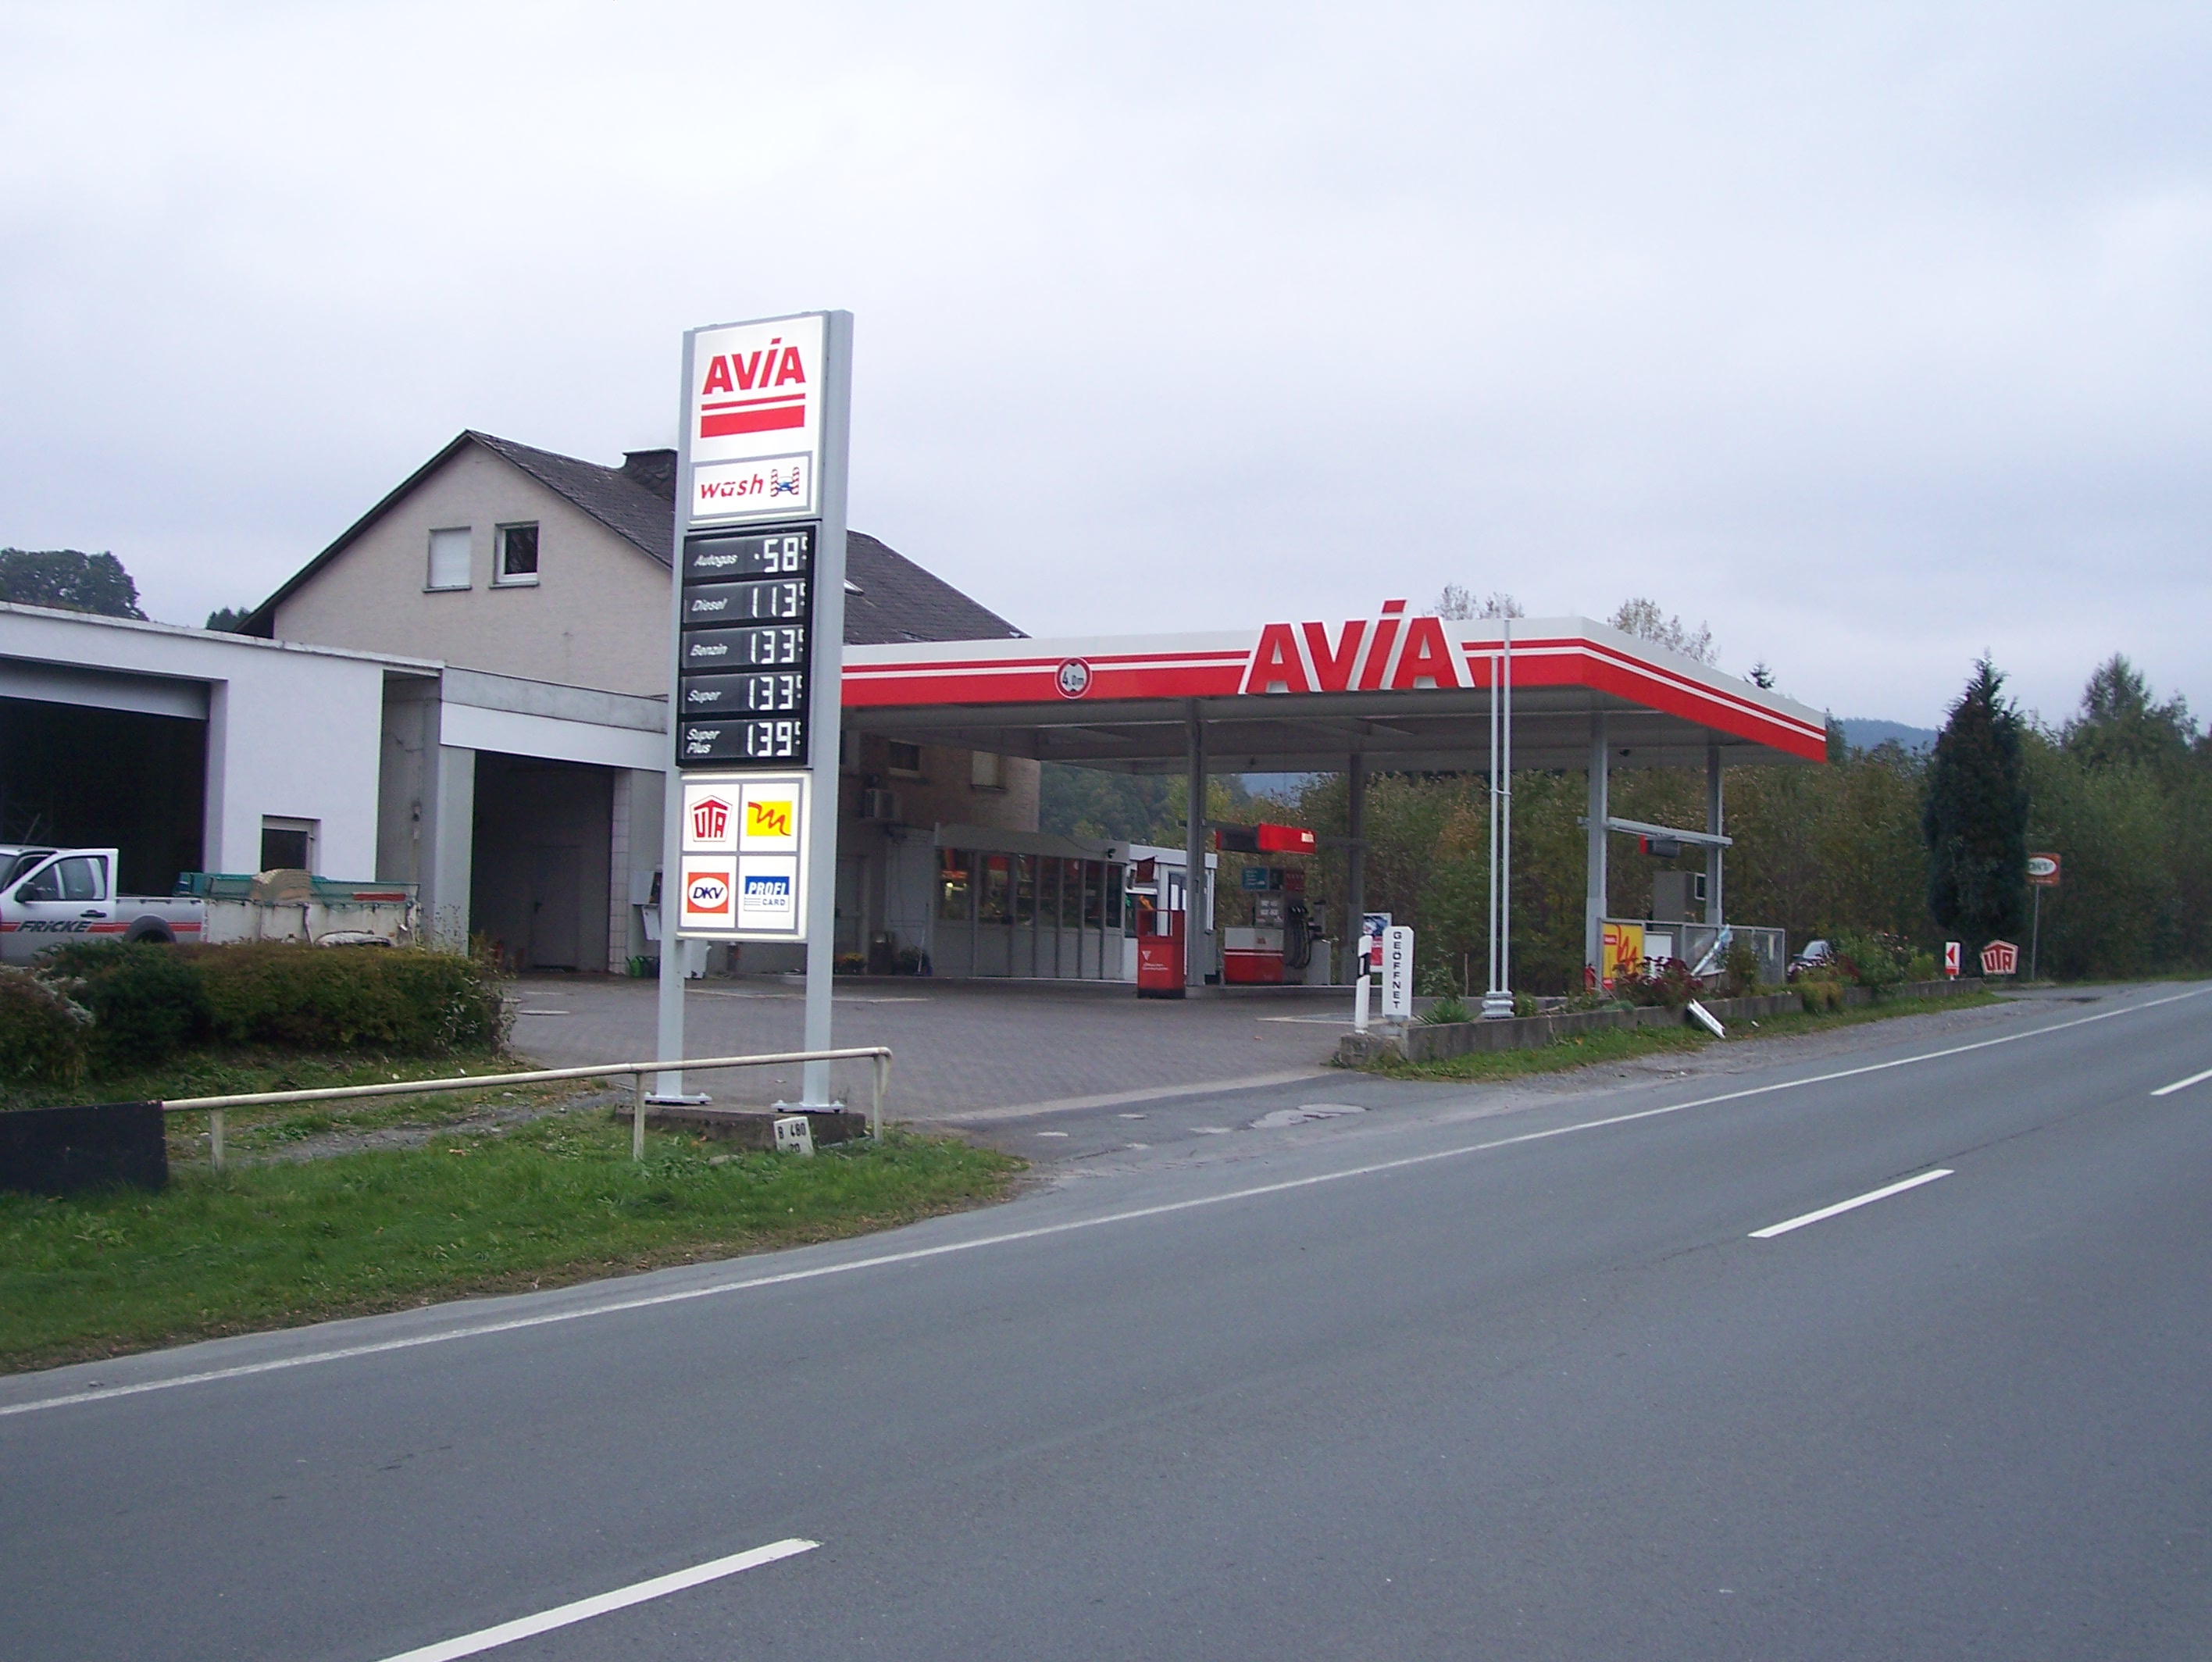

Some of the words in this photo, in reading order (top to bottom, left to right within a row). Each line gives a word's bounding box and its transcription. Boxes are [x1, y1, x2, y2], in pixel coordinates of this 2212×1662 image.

[701, 337, 806, 395] AVIA
[694, 554, 738, 568] Autogas
[691, 597, 728, 611] Diesel
[690, 643, 728, 656] Benzin
[1237, 598, 1475, 694] AVIA
[687, 689, 722, 704] Super
[687, 728, 720, 743] Super
[687, 741, 712, 754] Plus
[693, 886, 724, 899] DKV
[747, 881, 787, 896] PROFI
[762, 897, 786, 907] CARD
